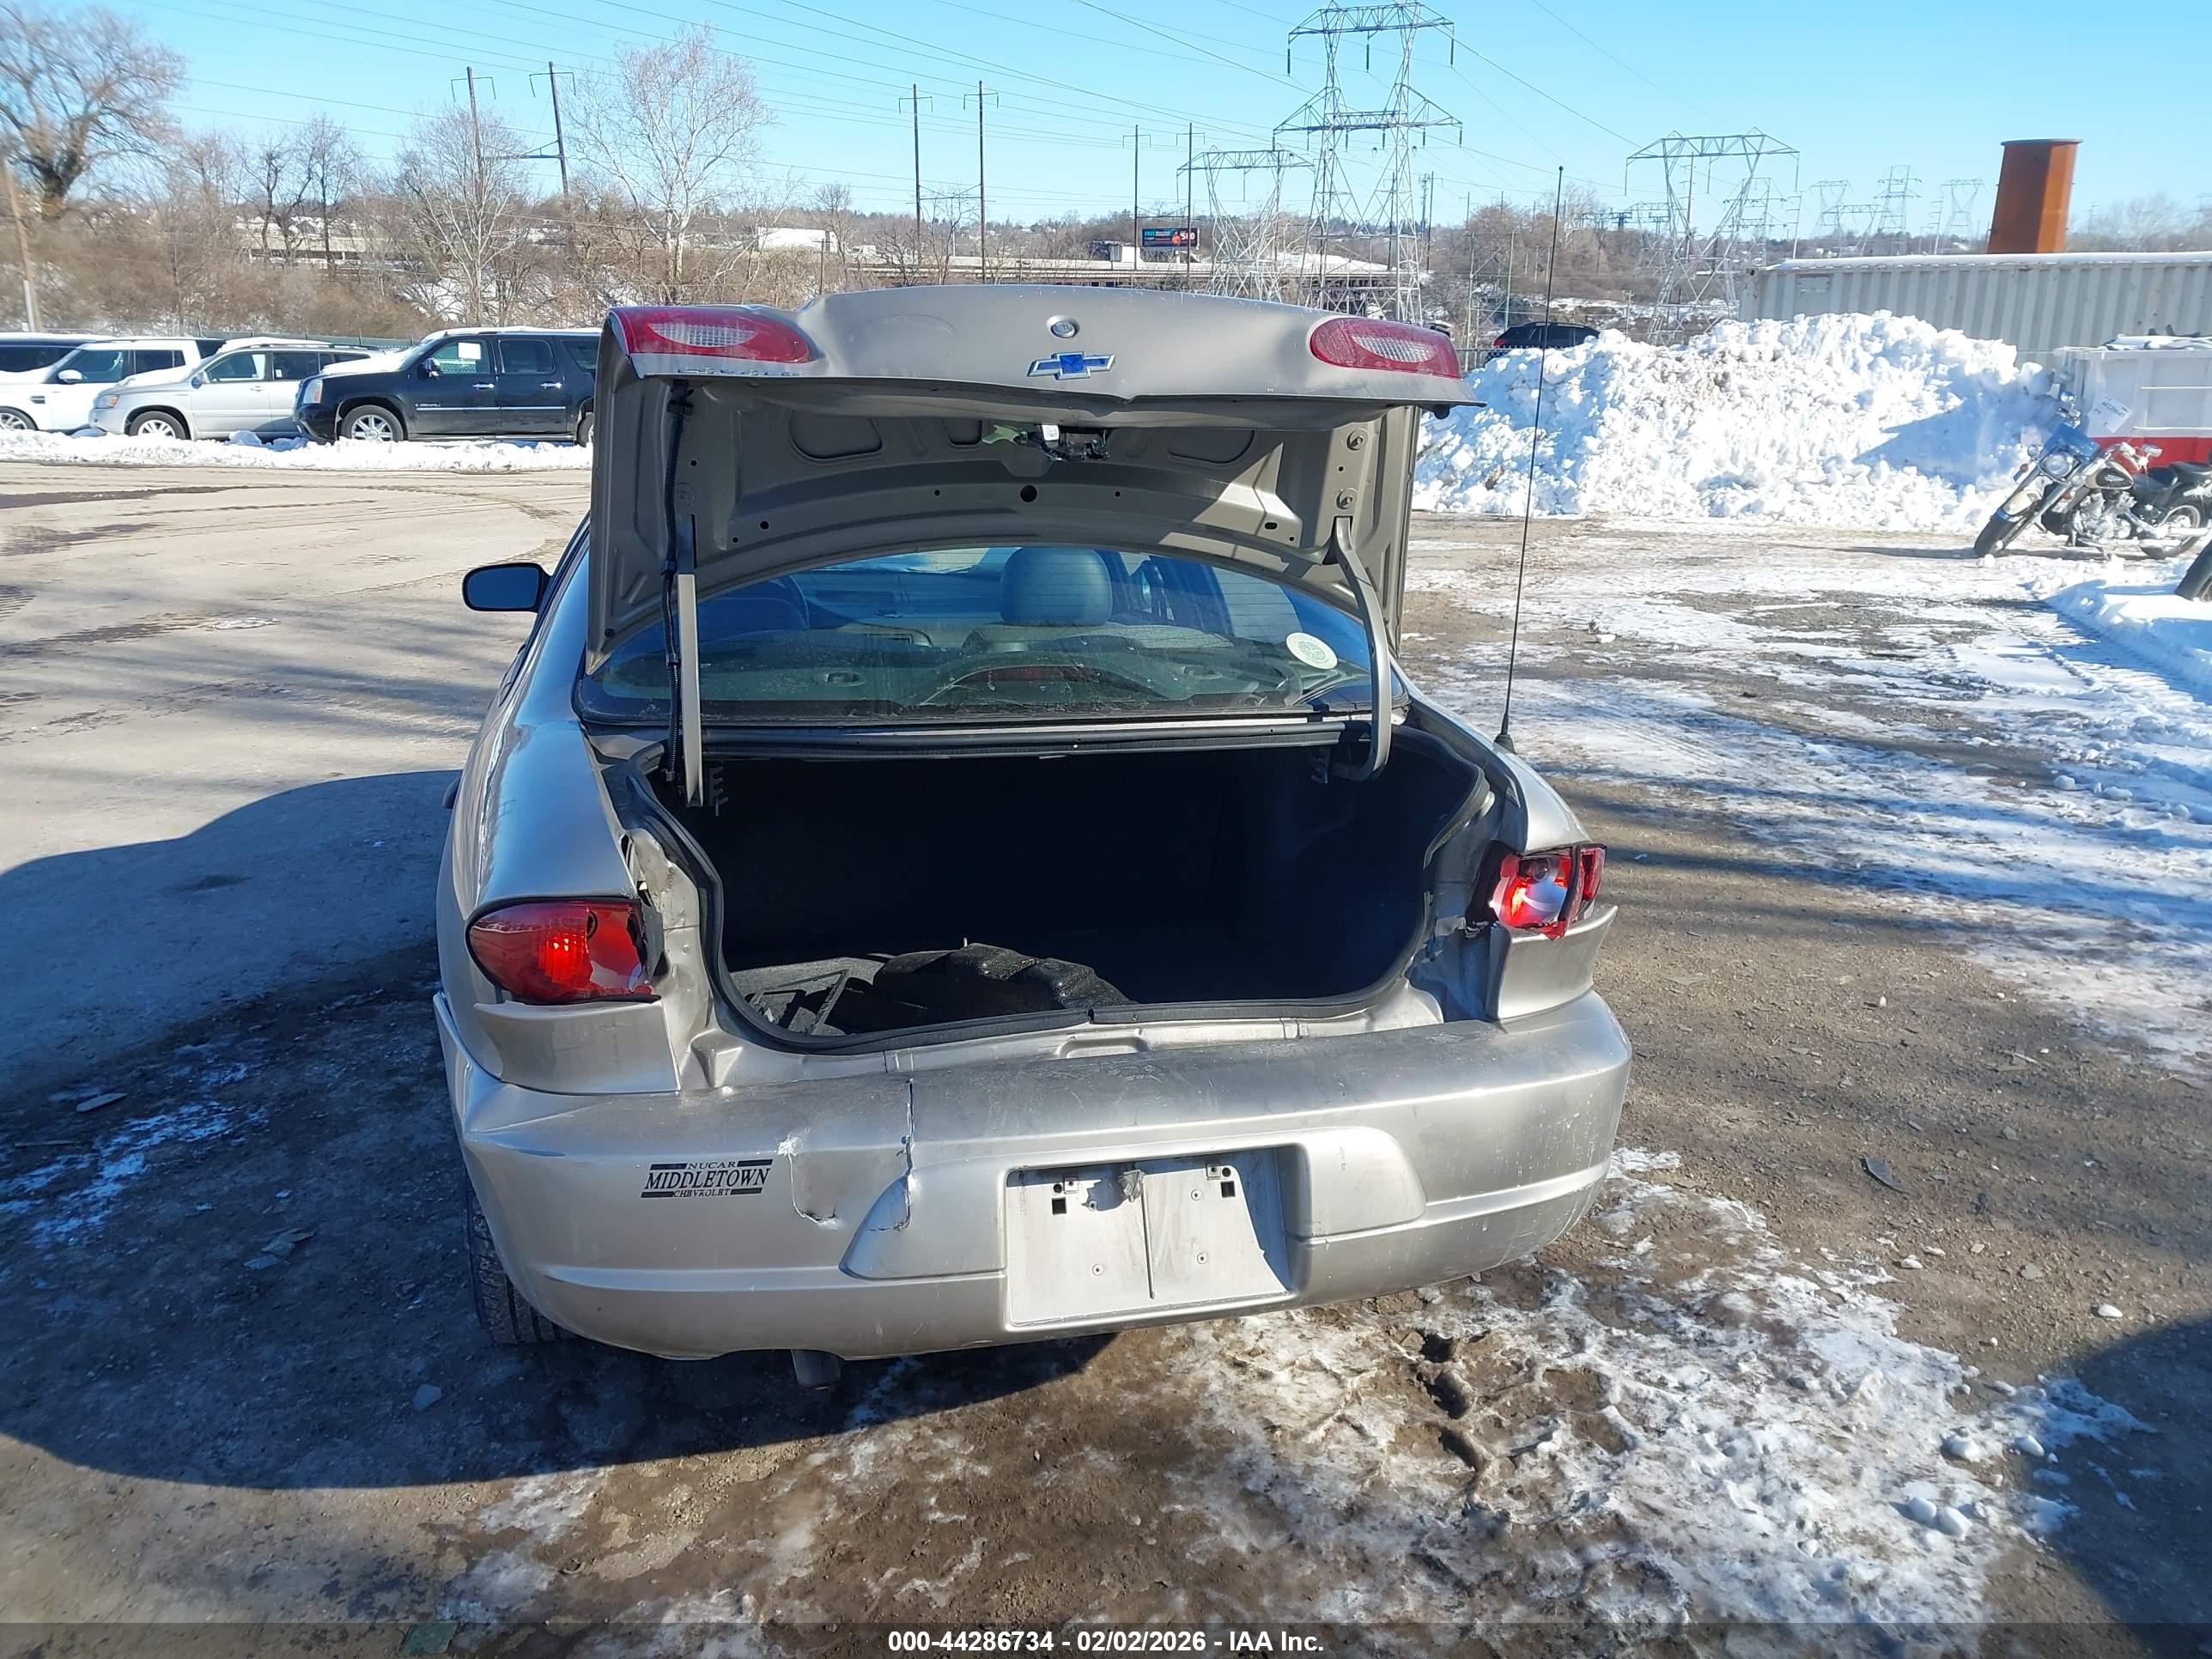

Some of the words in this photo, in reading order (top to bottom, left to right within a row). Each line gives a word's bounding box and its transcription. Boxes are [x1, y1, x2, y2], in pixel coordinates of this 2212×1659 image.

[687, 1161, 736, 1170] NUCAR
[644, 1168, 771, 1189] MIDDLETOWN
[673, 1188, 731, 1198] CHEVROLET
